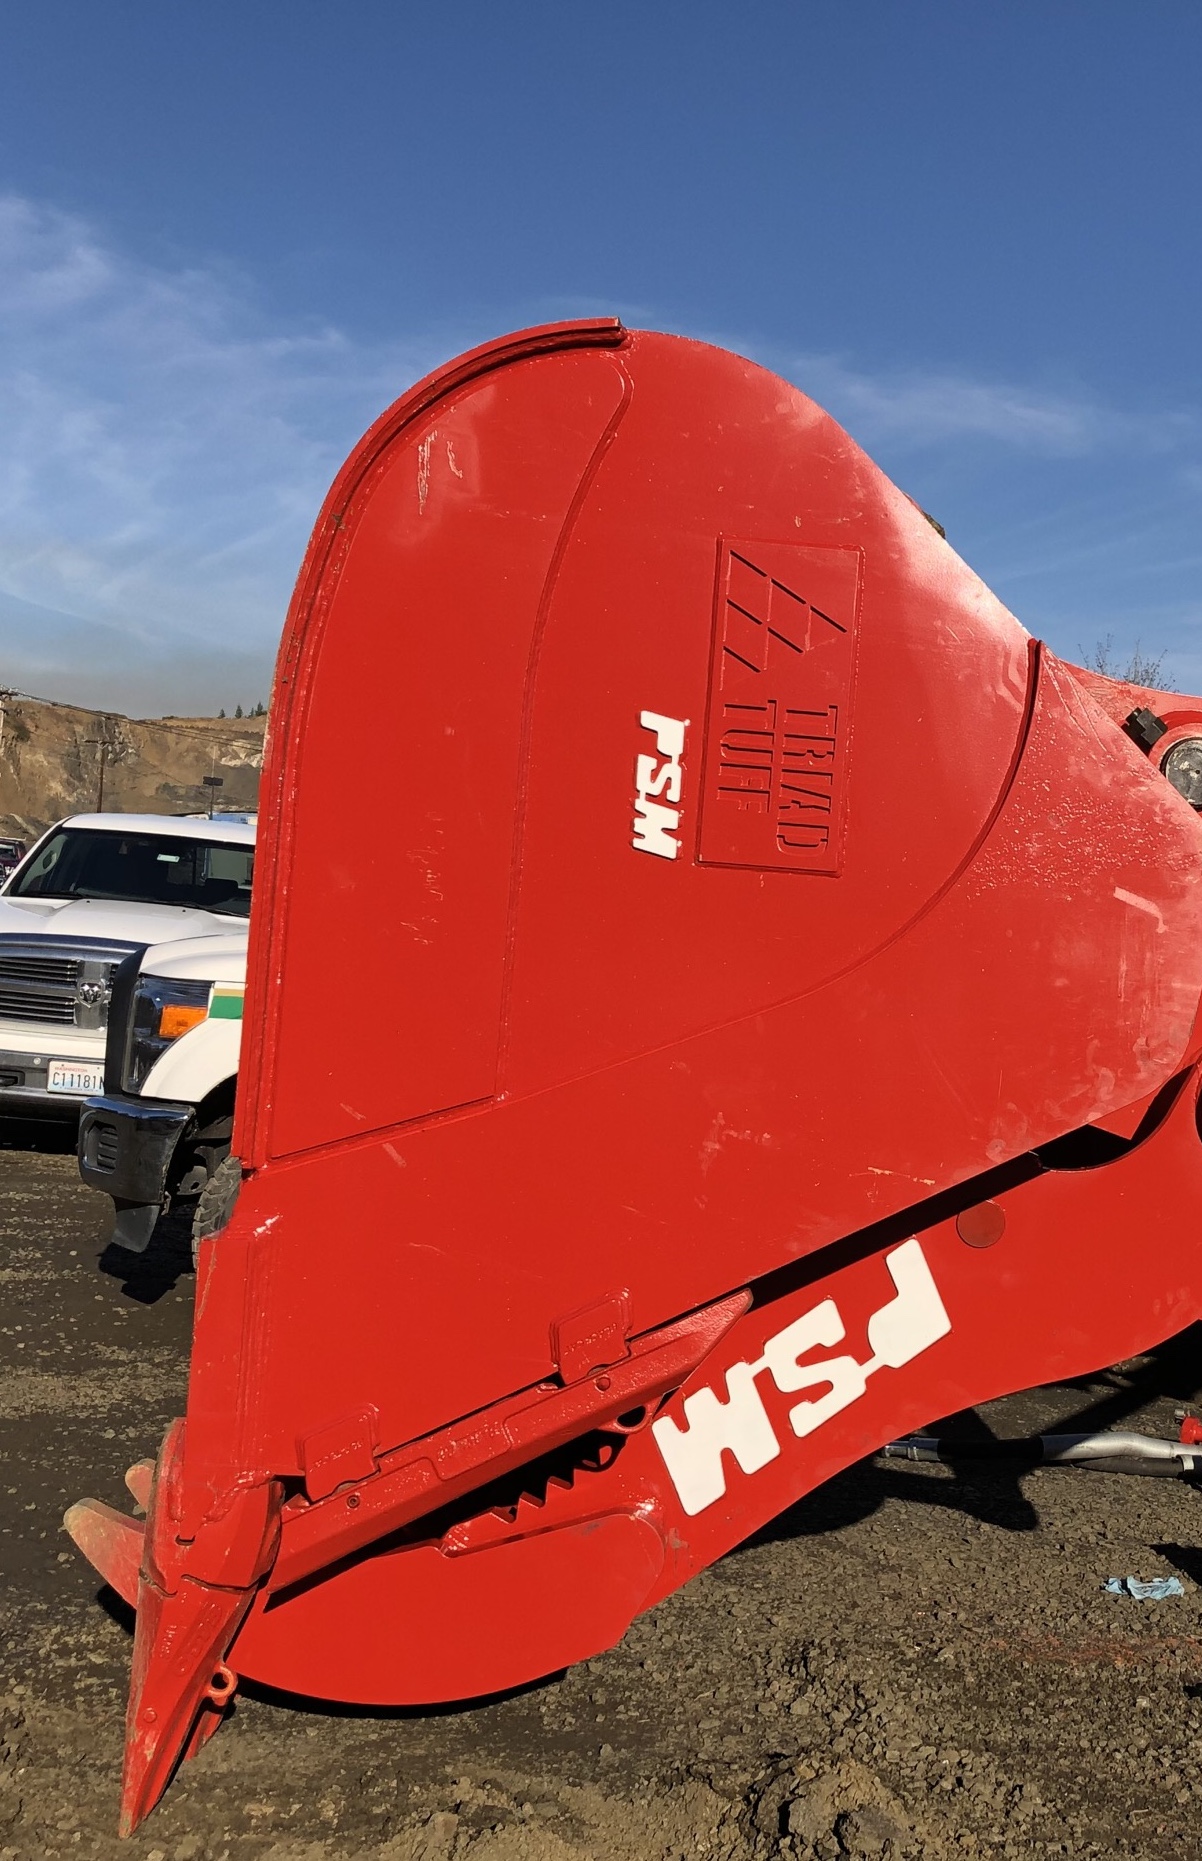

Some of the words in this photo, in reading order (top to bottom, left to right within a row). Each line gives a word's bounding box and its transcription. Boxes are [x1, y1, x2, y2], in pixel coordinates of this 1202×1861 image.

[633, 710, 686, 860] PSM
[717, 699, 777, 813] TUFF
[776, 704, 838, 856] TRIAD
[652, 1238, 951, 1516] PSM
